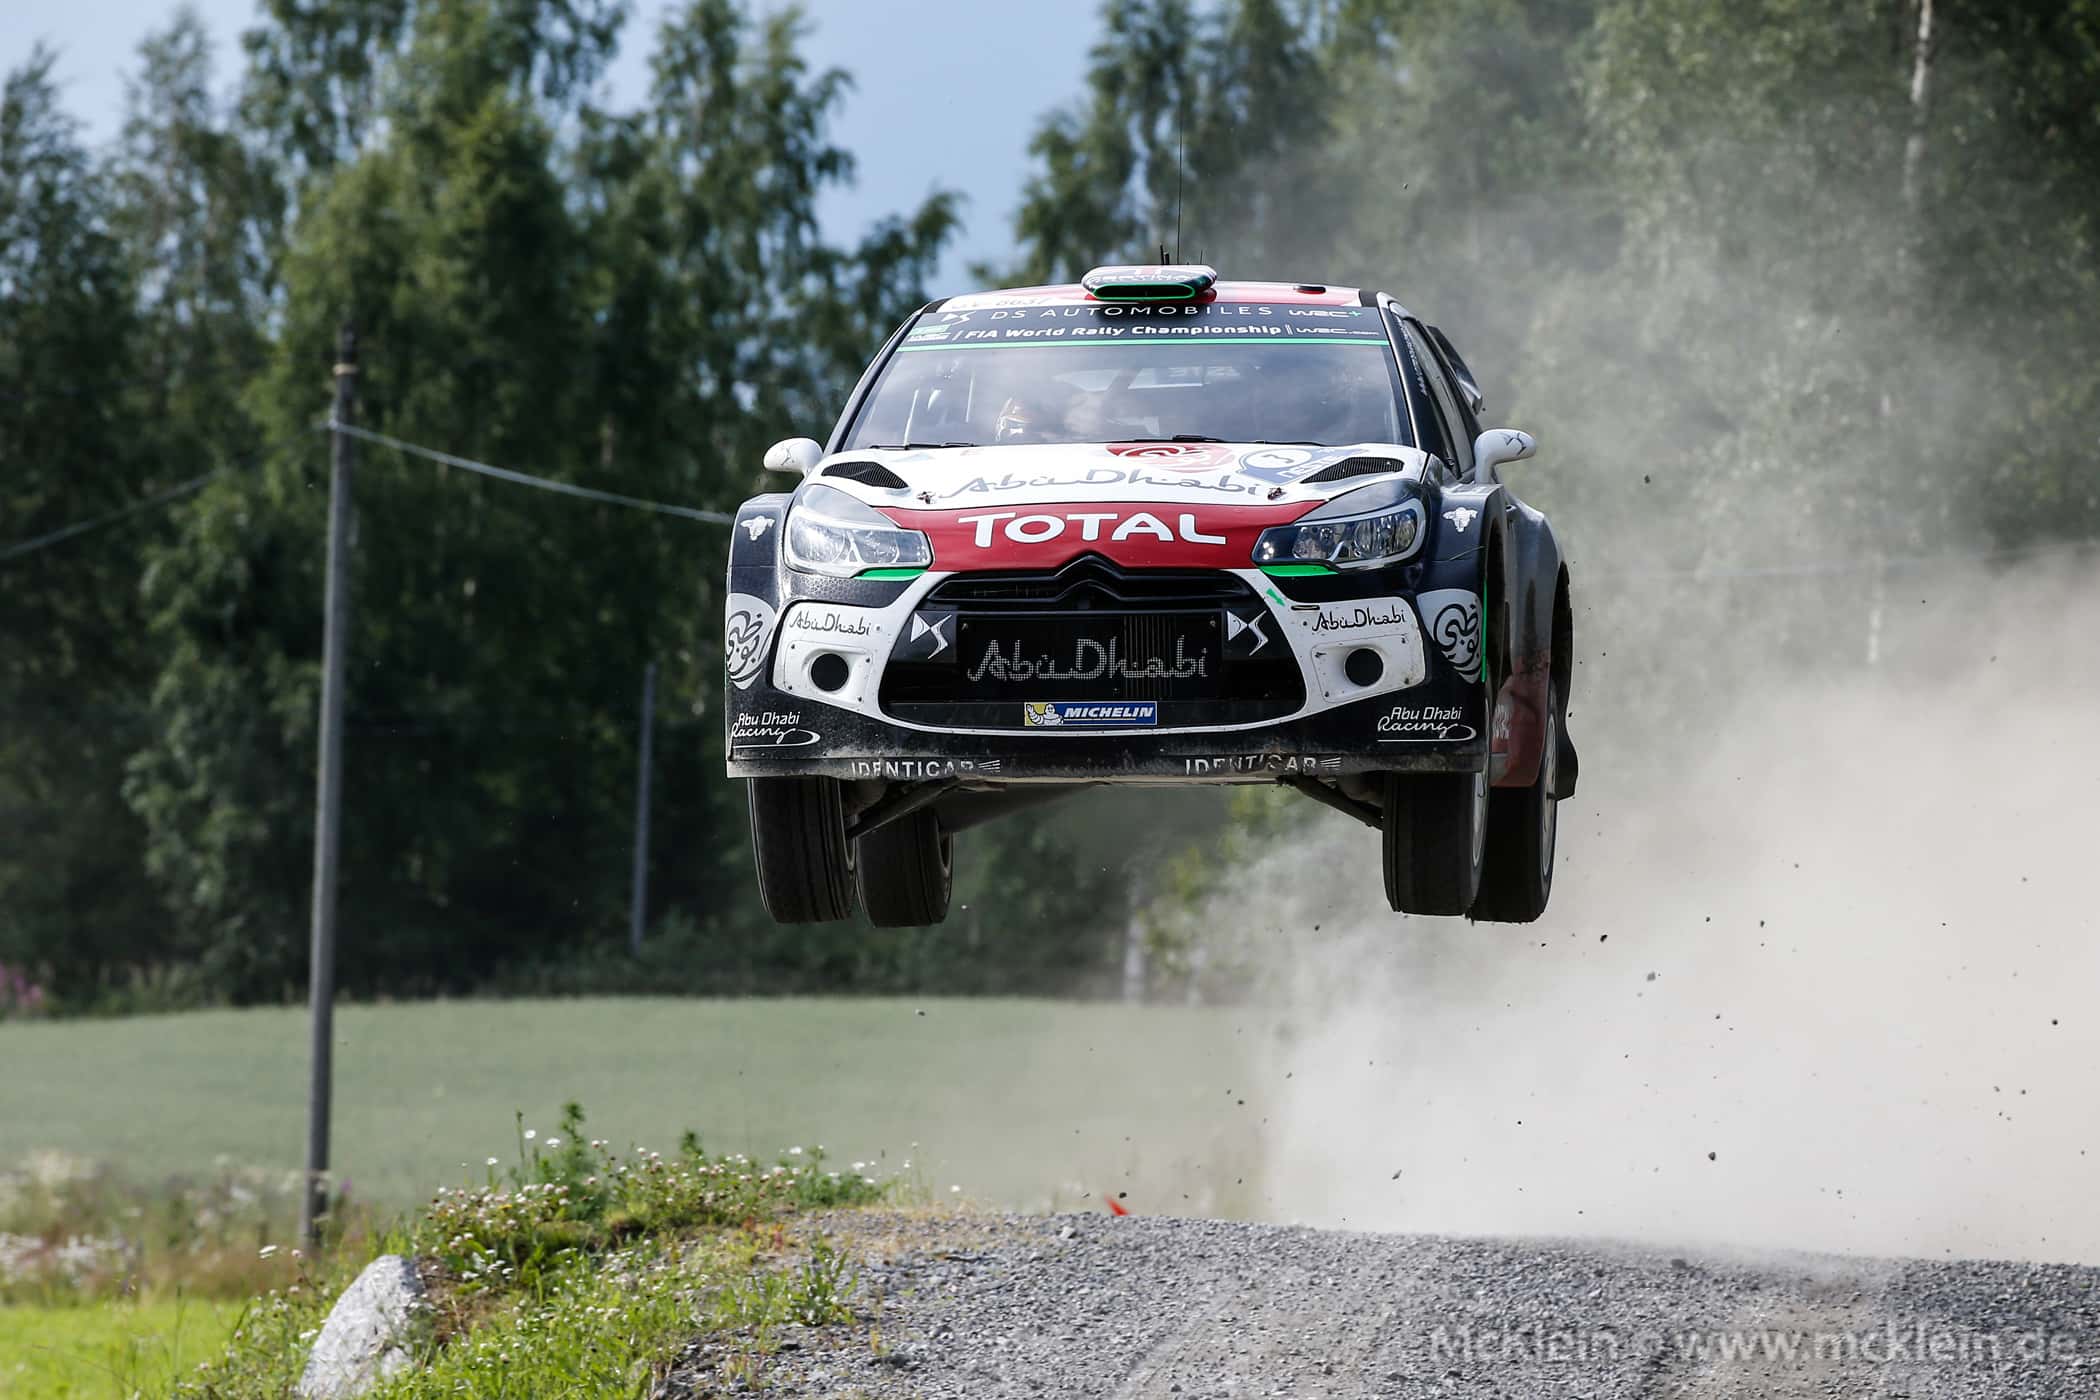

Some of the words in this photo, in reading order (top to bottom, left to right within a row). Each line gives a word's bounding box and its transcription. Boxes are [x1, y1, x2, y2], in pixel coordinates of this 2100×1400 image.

[991, 310, 1026, 320] DS
[1042, 306, 1273, 318] AUTOMOBILES
[964, 329, 998, 339] FIA
[1005, 327, 1060, 338] World
[1071, 327, 1125, 337] Rally
[1131, 325, 1282, 336] Championship
[958, 512, 1226, 548] TOTAL
[738, 714, 760, 726] Abu
[762, 711, 801, 725] Dhabi
[1063, 706, 1154, 718] MICHELIN
[1390, 707, 1419, 720] Abu
[1422, 706, 1462, 720] Dhabi
[731, 722, 797, 744] Racing
[1377, 716, 1459, 739] Racing
[1185, 754, 1317, 775] IDENTCAR
